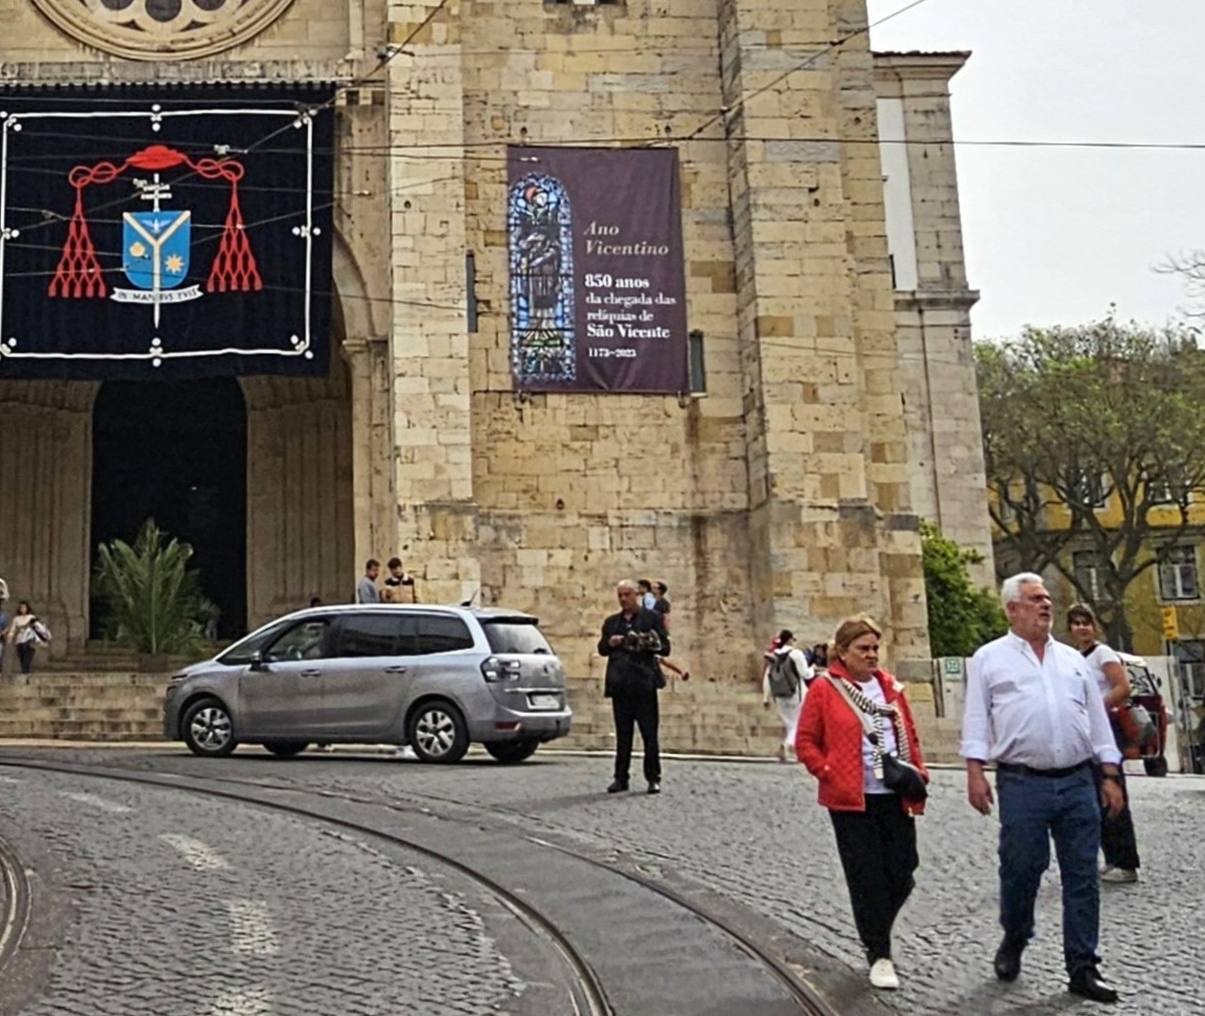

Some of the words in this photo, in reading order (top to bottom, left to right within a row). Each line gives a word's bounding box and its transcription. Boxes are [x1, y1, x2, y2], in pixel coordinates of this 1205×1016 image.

[583, 220, 620, 236] Ano
[585, 239, 670, 255] Vicentino
[584, 273, 613, 288] 850
[615, 277, 651, 289] anos
[585, 291, 602, 304] da
[603, 291, 653, 309] chegada
[655, 291, 676, 305] das
[586, 308, 637, 325] relíquias
[639, 309, 654, 322] de
[586, 323, 614, 338] São
[617, 323, 671, 339] Vicente
